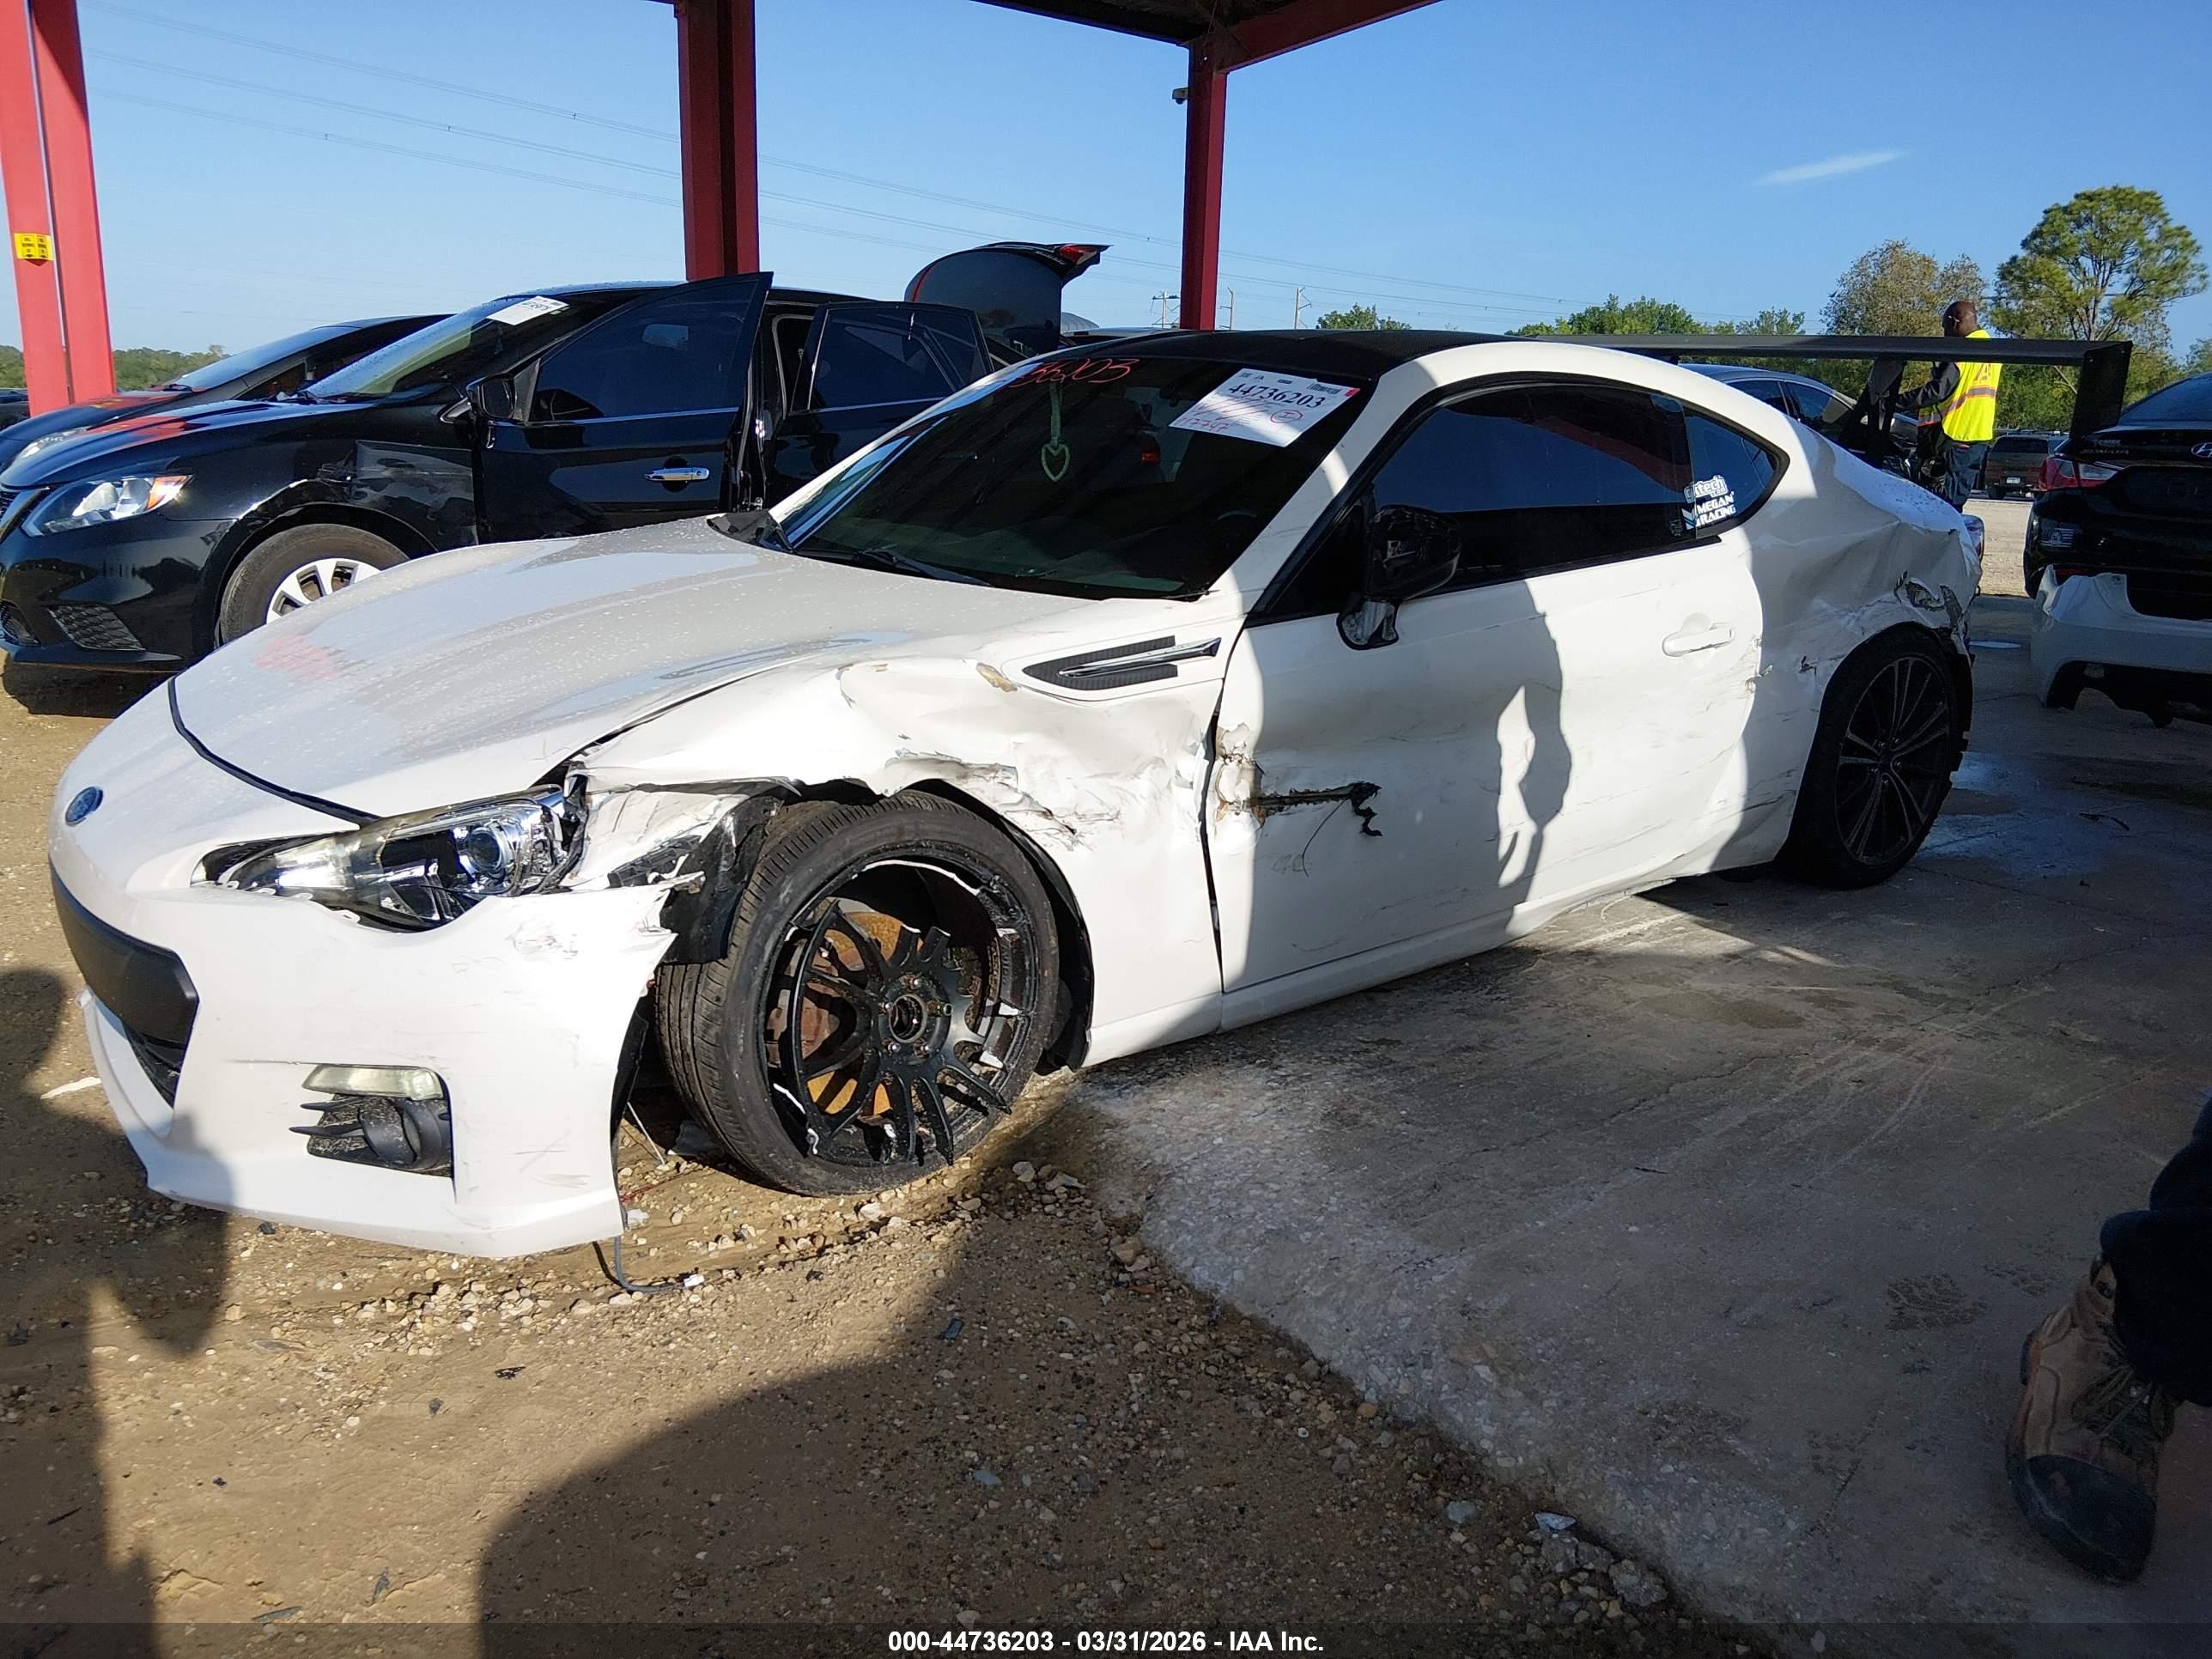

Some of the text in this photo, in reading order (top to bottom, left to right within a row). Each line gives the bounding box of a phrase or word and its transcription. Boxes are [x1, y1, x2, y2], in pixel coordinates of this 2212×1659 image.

[1228, 383, 1326, 409] 44736203
[1697, 495, 1734, 515] MEGAN
[1699, 504, 1736, 526] RACING
